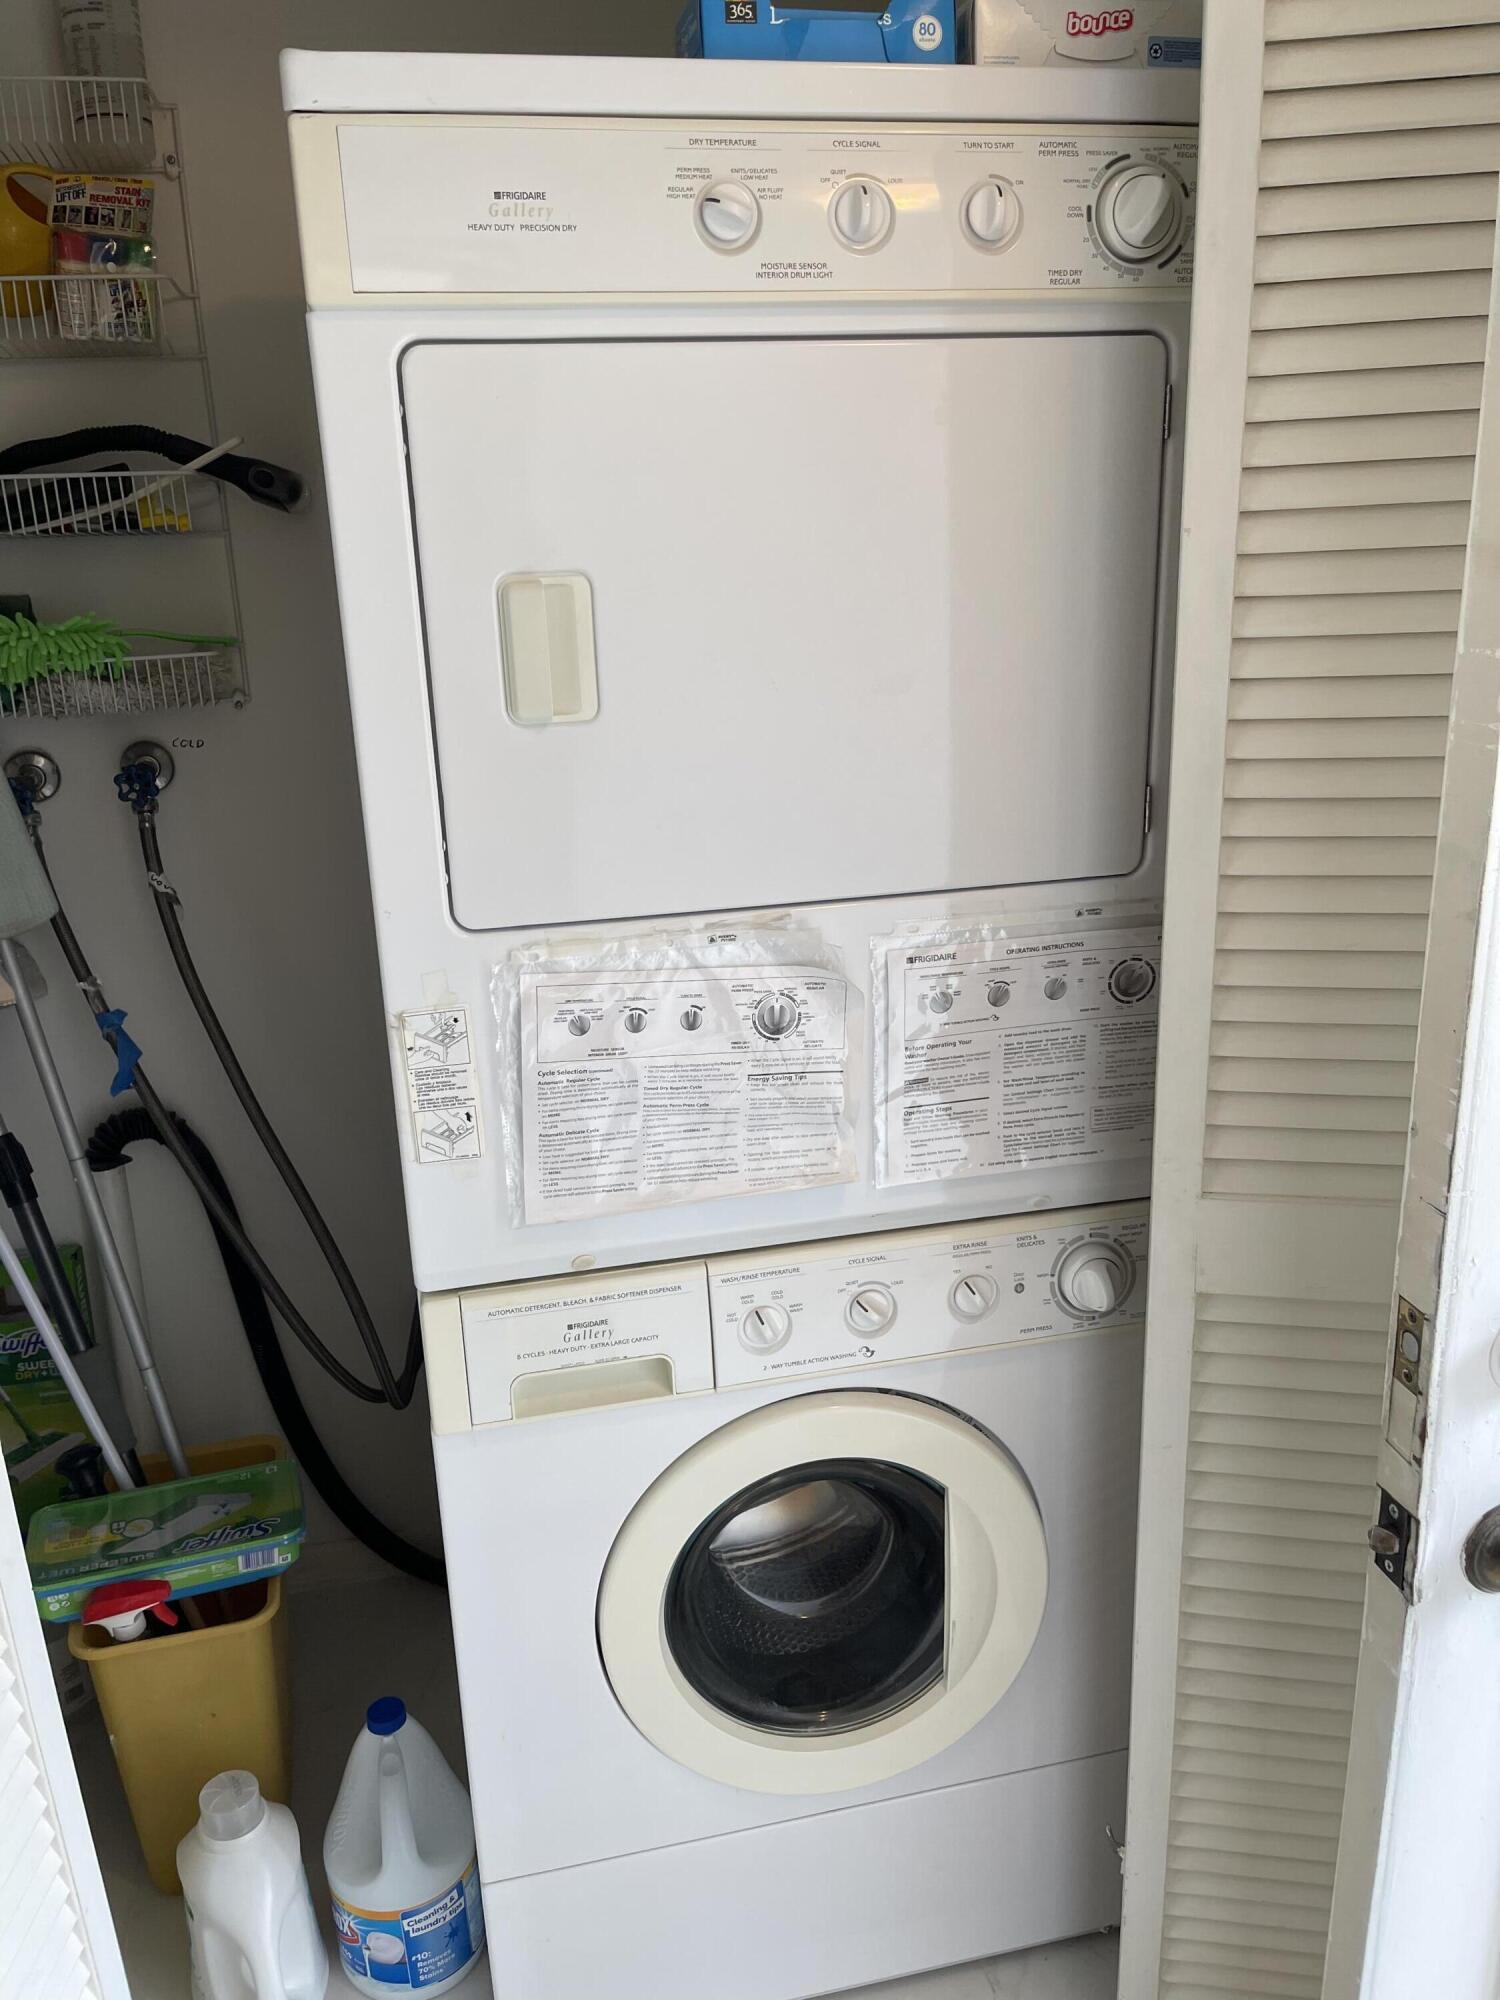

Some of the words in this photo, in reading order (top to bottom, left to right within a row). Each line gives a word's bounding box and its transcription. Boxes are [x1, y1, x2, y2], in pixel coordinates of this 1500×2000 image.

[730, 2, 753, 19] 365
[1066, 9, 1132, 35] bounce
[919, 22, 936, 36] 80
[689, 138, 704, 146] DRY
[705, 138, 757, 147] TEMPERATURE
[832, 140, 853, 148] CYCLE
[854, 140, 881, 148] SIGNAL
[994, 142, 1015, 150] START
[1038, 141, 1078, 149] AUTOMATIC
[699, 173, 713, 181] HEAT
[114, 186, 142, 197] STAIN
[501, 191, 547, 201] FRIGIDAIRE
[89, 193, 134, 206] REMOVAL
[135, 198, 152, 208] KIT
[488, 201, 554, 221] Gallery
[467, 223, 492, 232] HEAVY
[494, 223, 515, 232] DUTY
[519, 223, 561, 232] PRECISION
[562, 224, 577, 232] DRY
[760, 262, 797, 270] MOISTURE
[798, 262, 828, 270] SENSOR
[755, 271, 789, 279] INTERIOR
[790, 271, 812, 279] DRUM
[813, 271, 834, 279] LIGHT
[1048, 269, 1069, 277] TIMED
[1069, 269, 1083, 277] DRY
[1050, 278, 1081, 286] REGULAR
[172, 737, 205, 749] COLD
[914, 952, 958, 964] FRIGIDAIRE
[1006, 945, 1040, 955] OPERATING
[1042, 941, 1085, 951] INSTRUCTIONS
[926, 1040, 957, 1050] Operating
[537, 1069, 556, 1078] Cycle
[556, 1068, 588, 1076] Selection
[747, 1075, 770, 1083] Energy
[952, 1241, 971, 1251] EXTRA
[971, 1240, 988, 1248] RINSE
[1016, 1239, 1046, 1249] DELICATES
[848, 1257, 866, 1266] CYCLE
[866, 1255, 887, 1263] SIGNAL
[720, 1272, 759, 1284] WASH/RINSE
[759, 1267, 800, 1279] TEMPERATURE
[487, 1307, 523, 1317] AUTOMATIC
[594, 1294, 616, 1303] FABRIC
[616, 1289, 649, 1299] SOFTENER
[648, 1284, 682, 1295] DISPENSER
[573, 1318, 609, 1330] FRIGIDAIRE
[1019, 1326, 1035, 1334] PERM
[1035, 1324, 1053, 1332] PRESS
[563, 1328, 614, 1344] Gallery
[522, 1350, 546, 1359] CYCLES
[548, 1347, 570, 1355] HEAVY
[570, 1344, 588, 1353] DUTY
[590, 1341, 610, 1350] EXTRA
[610, 1338, 631, 1347] LARGE
[630, 1334, 660, 1343] CAPACITY
[17, 1359, 56, 1372] SWEE
[771, 1361, 784, 1370] WAY
[784, 1357, 807, 1368] TUMBLE
[807, 1354, 829, 1364] ACTION
[829, 1351, 857, 1361] WASHING
[172, 1518, 281, 1555] Swiffer
[80, 1552, 158, 1574] SWEEPER
[38, 1564, 76, 1580] WET
[407, 1901, 448, 1928] Cleaning
[449, 1895, 455, 1903] &
[411, 1913, 447, 1934] laundry
[448, 1902, 463, 1916] tips
